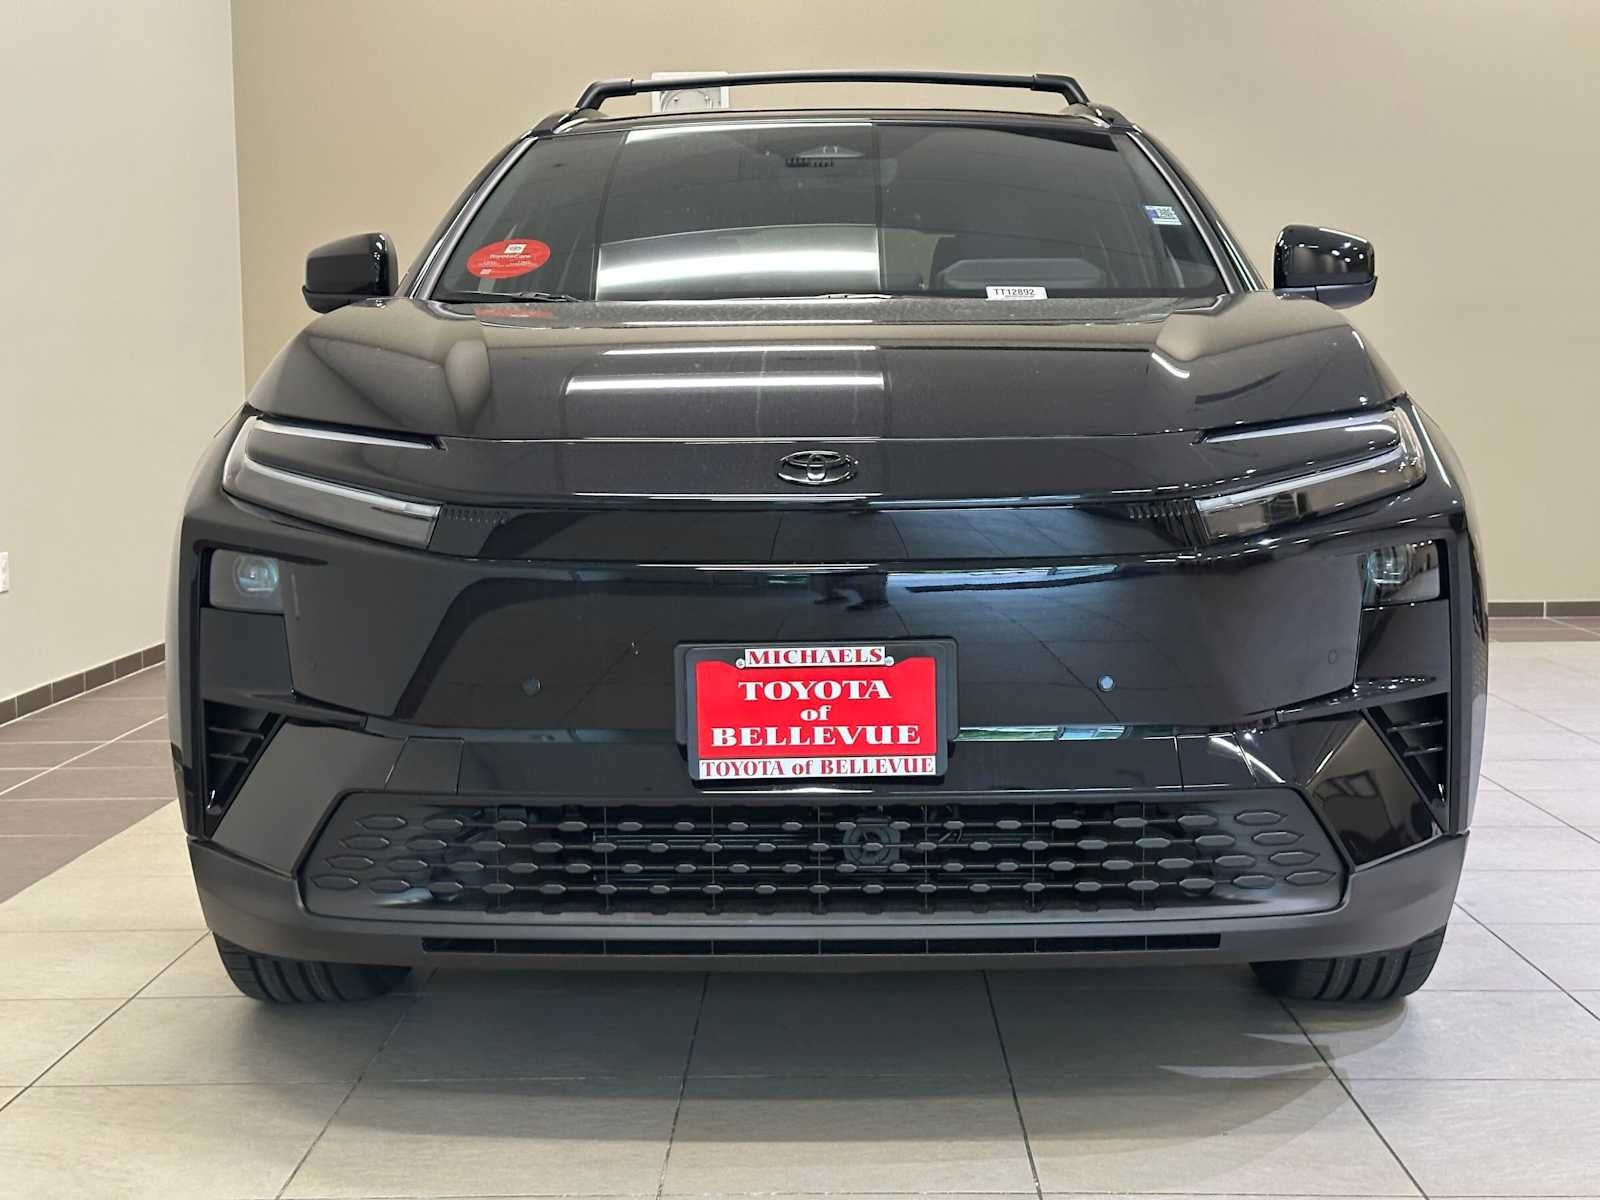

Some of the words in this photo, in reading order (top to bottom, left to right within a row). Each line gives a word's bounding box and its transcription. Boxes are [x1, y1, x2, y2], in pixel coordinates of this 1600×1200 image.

[992, 288, 1034, 296] TT12892
[748, 648, 883, 665] MICHAELS
[738, 680, 891, 701] TOYOTA
[800, 705, 831, 721] of
[711, 725, 921, 747] BELLEVUE
[702, 760, 784, 777] TOYOTA
[792, 760, 813, 775] of
[820, 757, 934, 775] BELLEVUE
